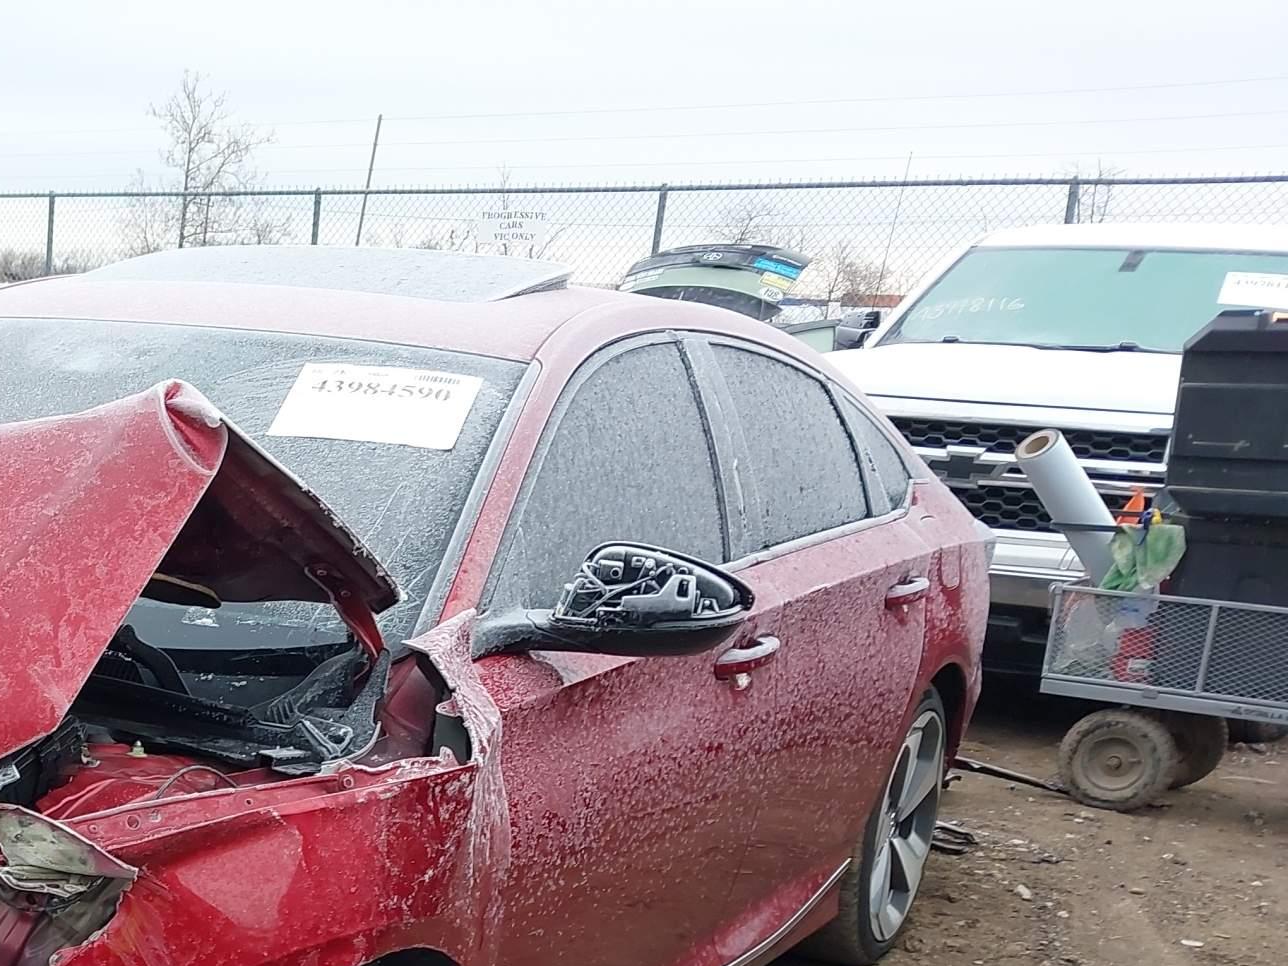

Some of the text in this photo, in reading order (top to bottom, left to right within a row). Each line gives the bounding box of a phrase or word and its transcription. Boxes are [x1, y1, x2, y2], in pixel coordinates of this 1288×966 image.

[482, 211, 547, 221] PROGRESSIVE
[499, 221, 524, 230] CARS
[511, 232, 536, 241] ONLY
[311, 379, 452, 401] 43984590
